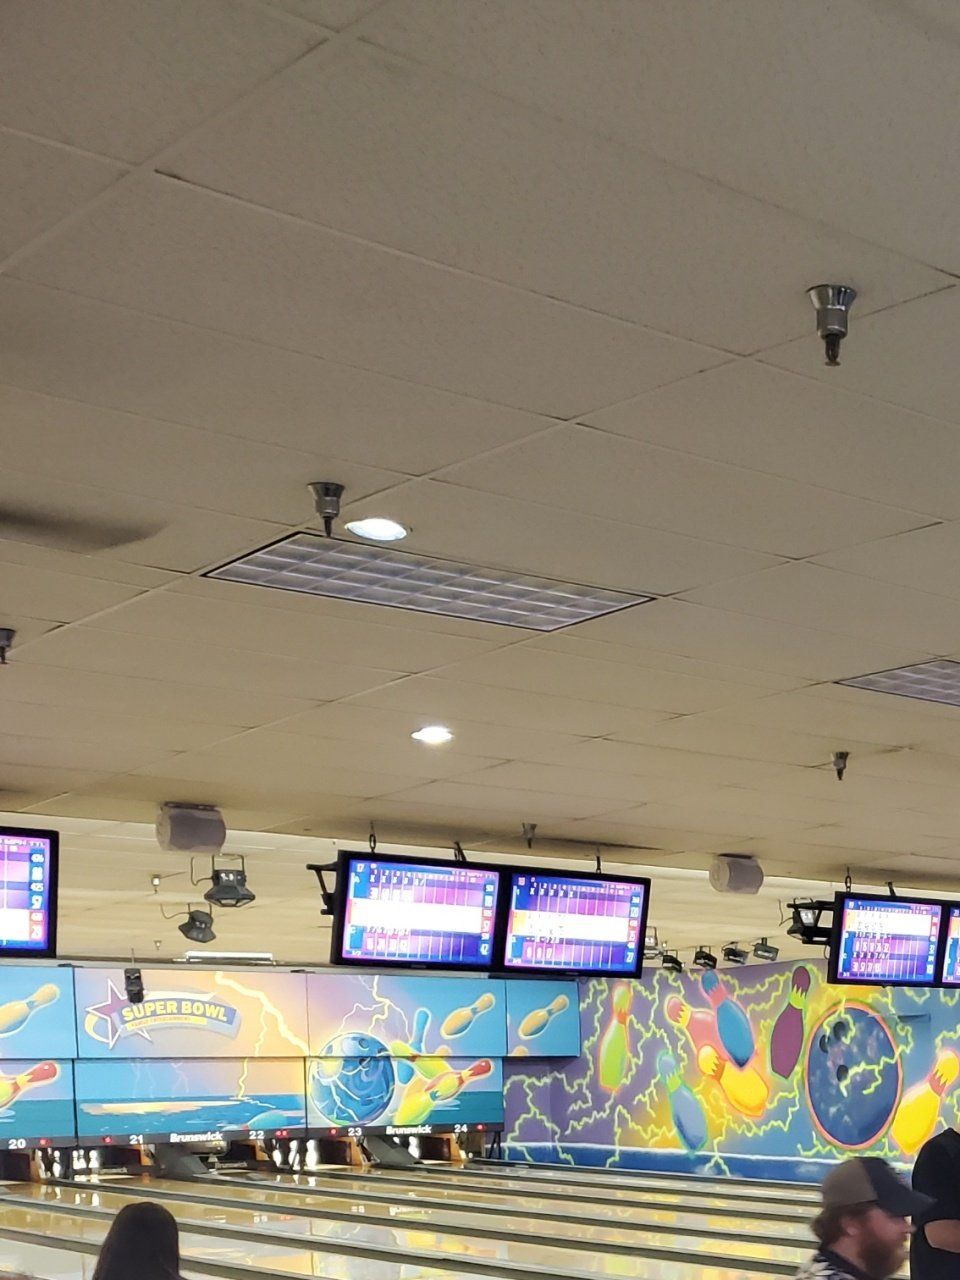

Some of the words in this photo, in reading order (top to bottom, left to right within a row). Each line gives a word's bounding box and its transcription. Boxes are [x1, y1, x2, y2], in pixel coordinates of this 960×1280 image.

[121, 1000, 178, 1022] SUPER
[181, 1000, 228, 1022] BOWL
[348, 1127, 362, 1136] 23
[385, 1124, 432, 1135] Brunswick
[454, 1124, 468, 1133] 24
[129, 1134, 145, 1144] 21
[169, 1131, 224, 1143] Brunswick
[249, 1130, 265, 1140] 22
[8, 1138, 27, 1150] 20
